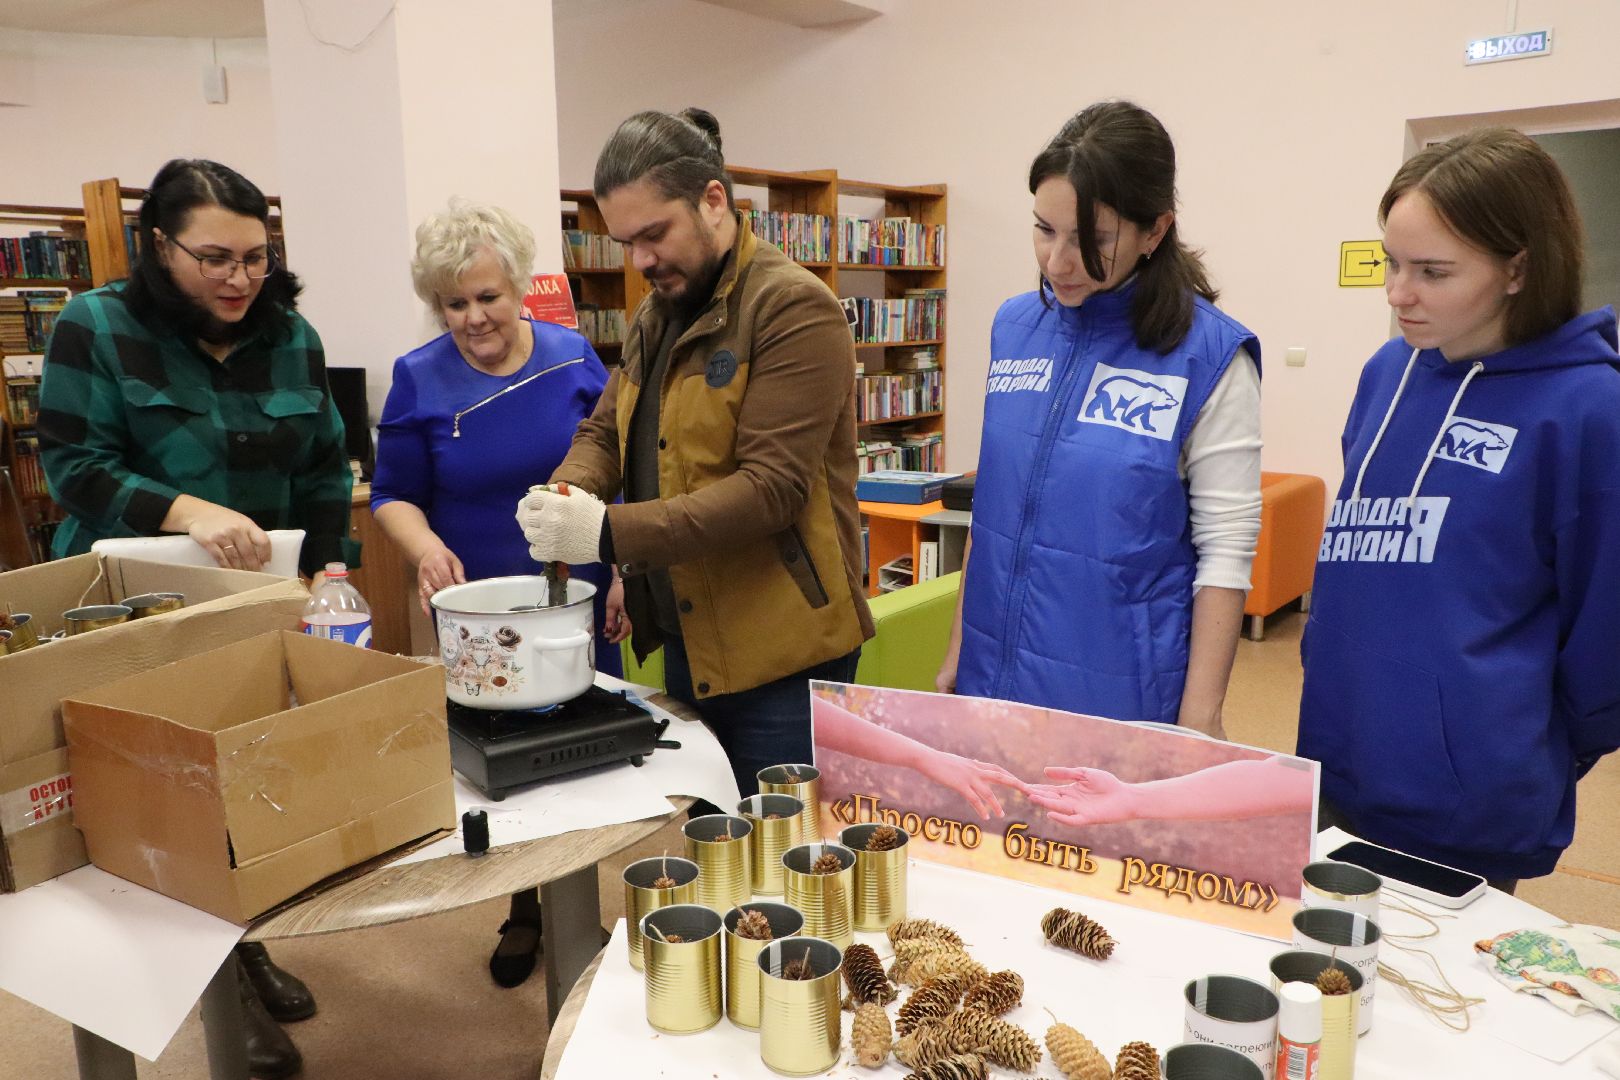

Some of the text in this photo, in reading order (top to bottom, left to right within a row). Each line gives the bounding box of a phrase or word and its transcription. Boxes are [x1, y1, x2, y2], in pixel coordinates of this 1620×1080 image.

[1471, 34, 1543, 59] ВЫХОД
[527, 279, 562, 296] ОЛКА
[1328, 497, 1450, 528] ОЛОДАЯ
[1318, 530, 1440, 563] ВАРДИЯ
[831, 793, 1280, 912] «Просто быть рядом»
